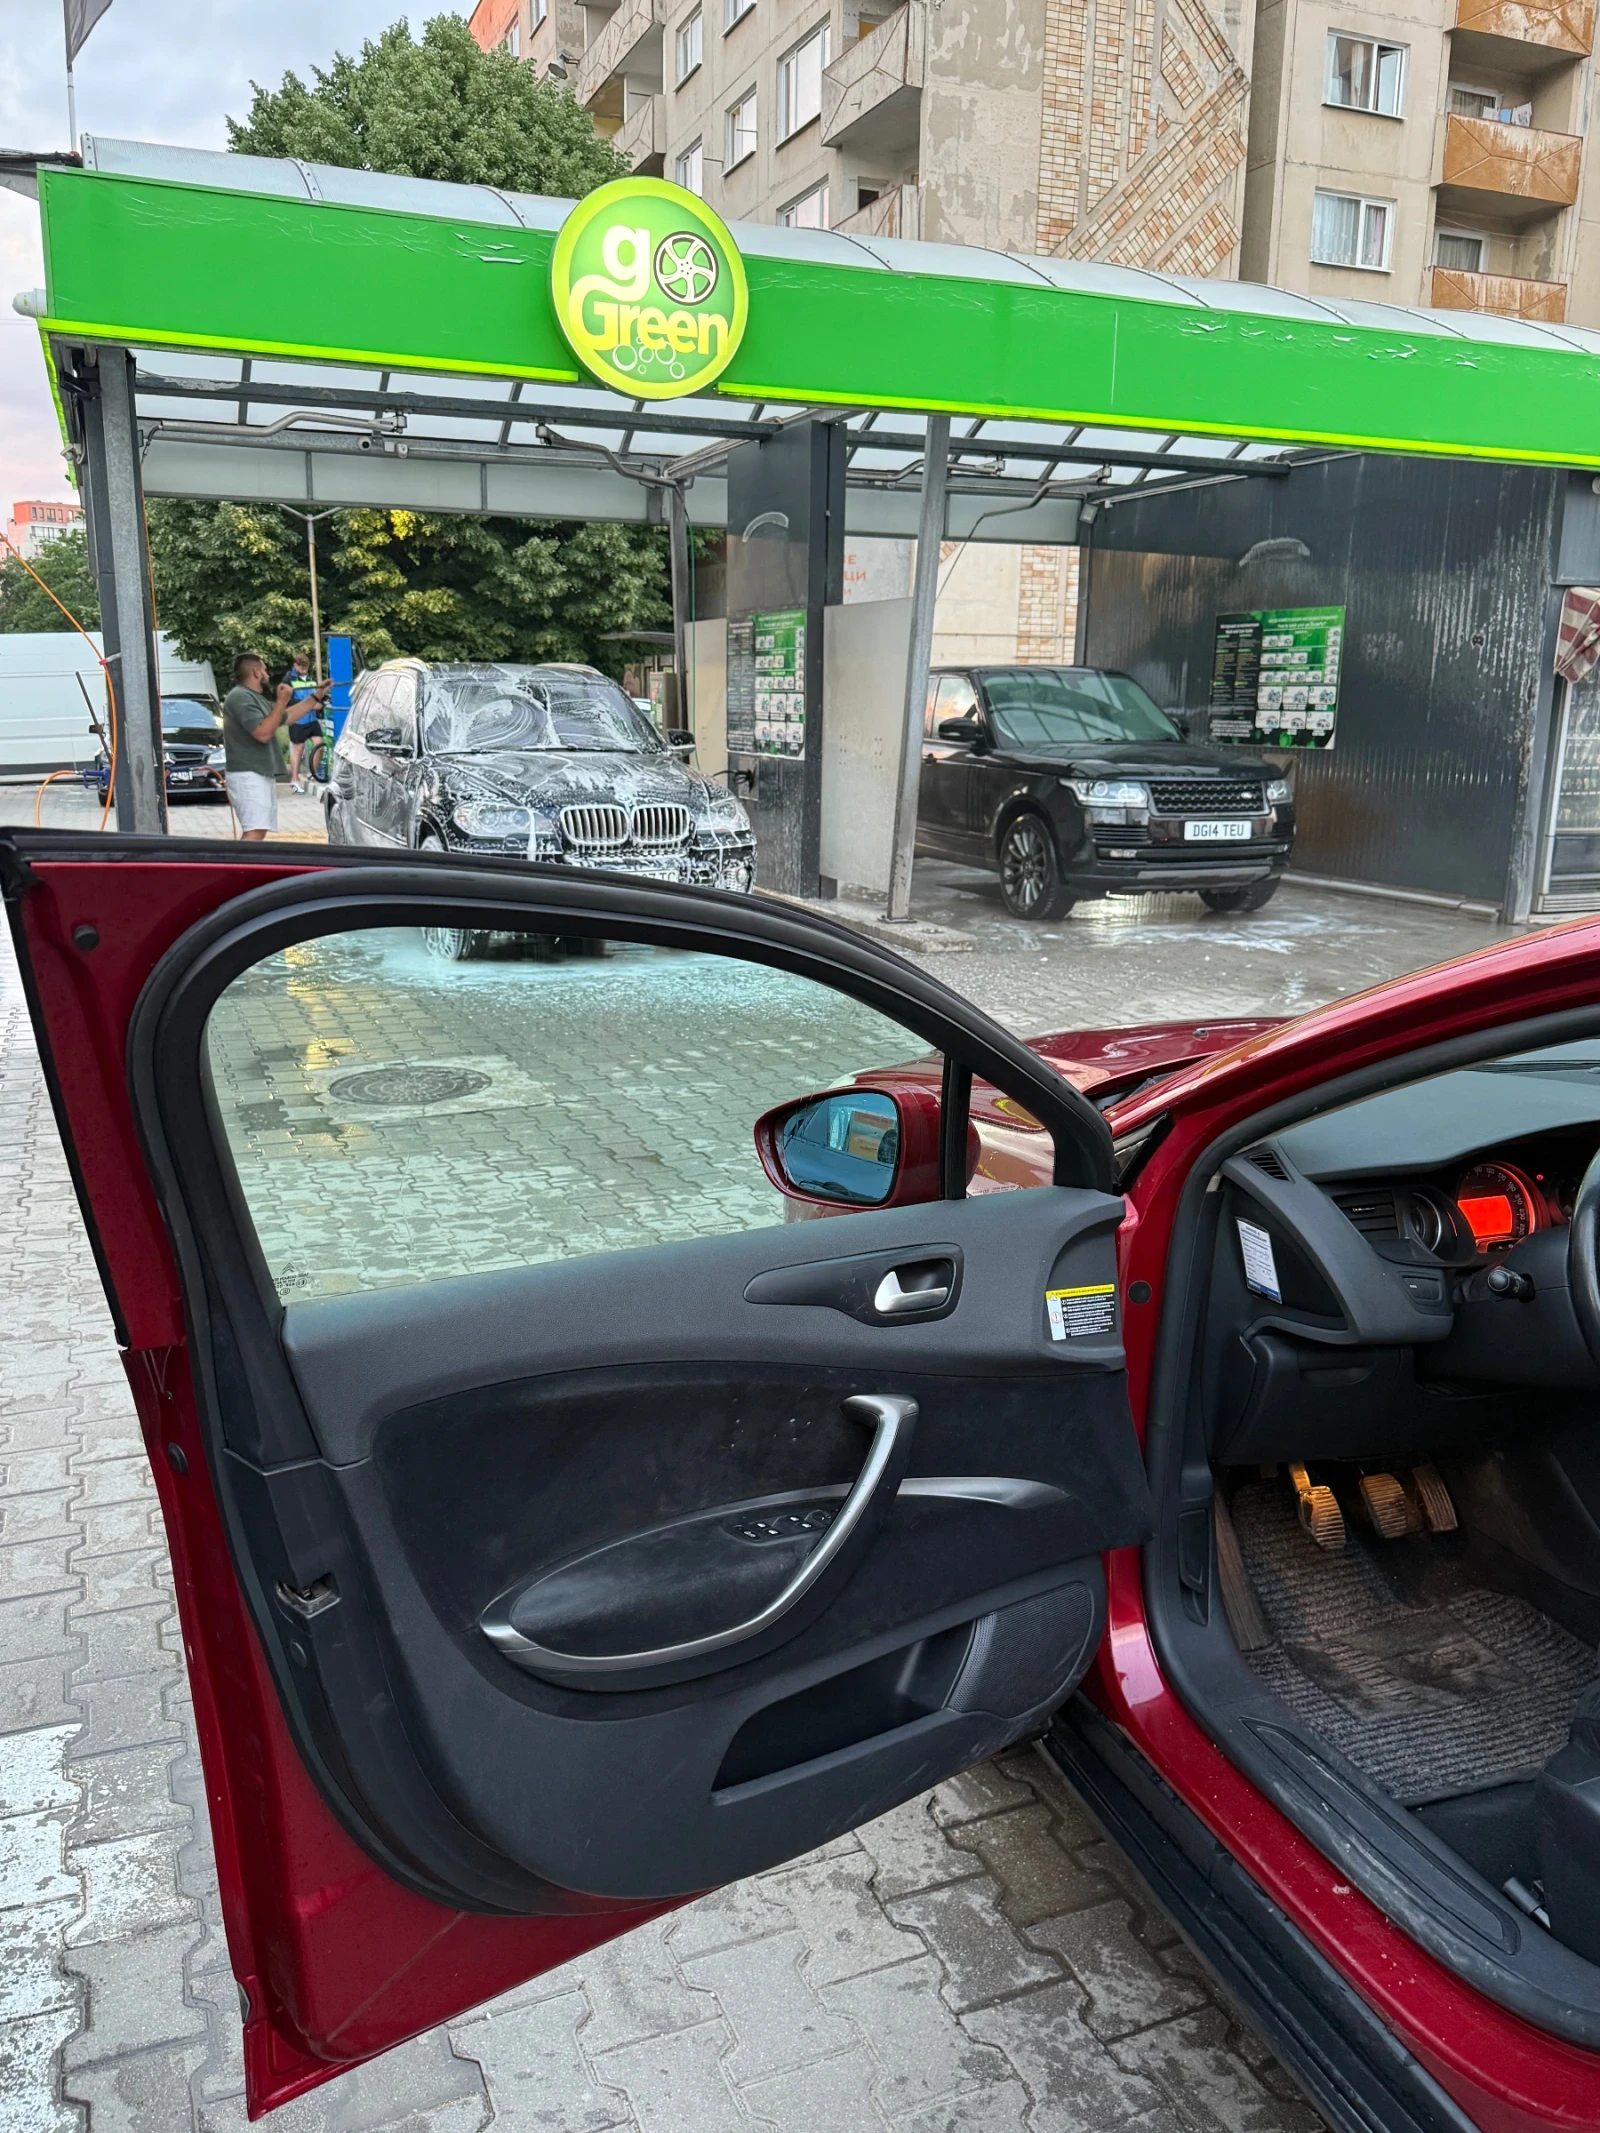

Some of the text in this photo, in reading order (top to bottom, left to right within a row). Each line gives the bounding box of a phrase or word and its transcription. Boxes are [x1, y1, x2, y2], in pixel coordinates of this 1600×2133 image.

[569, 275, 729, 356] Green
[1193, 823, 1245, 837] DG14 TEU
